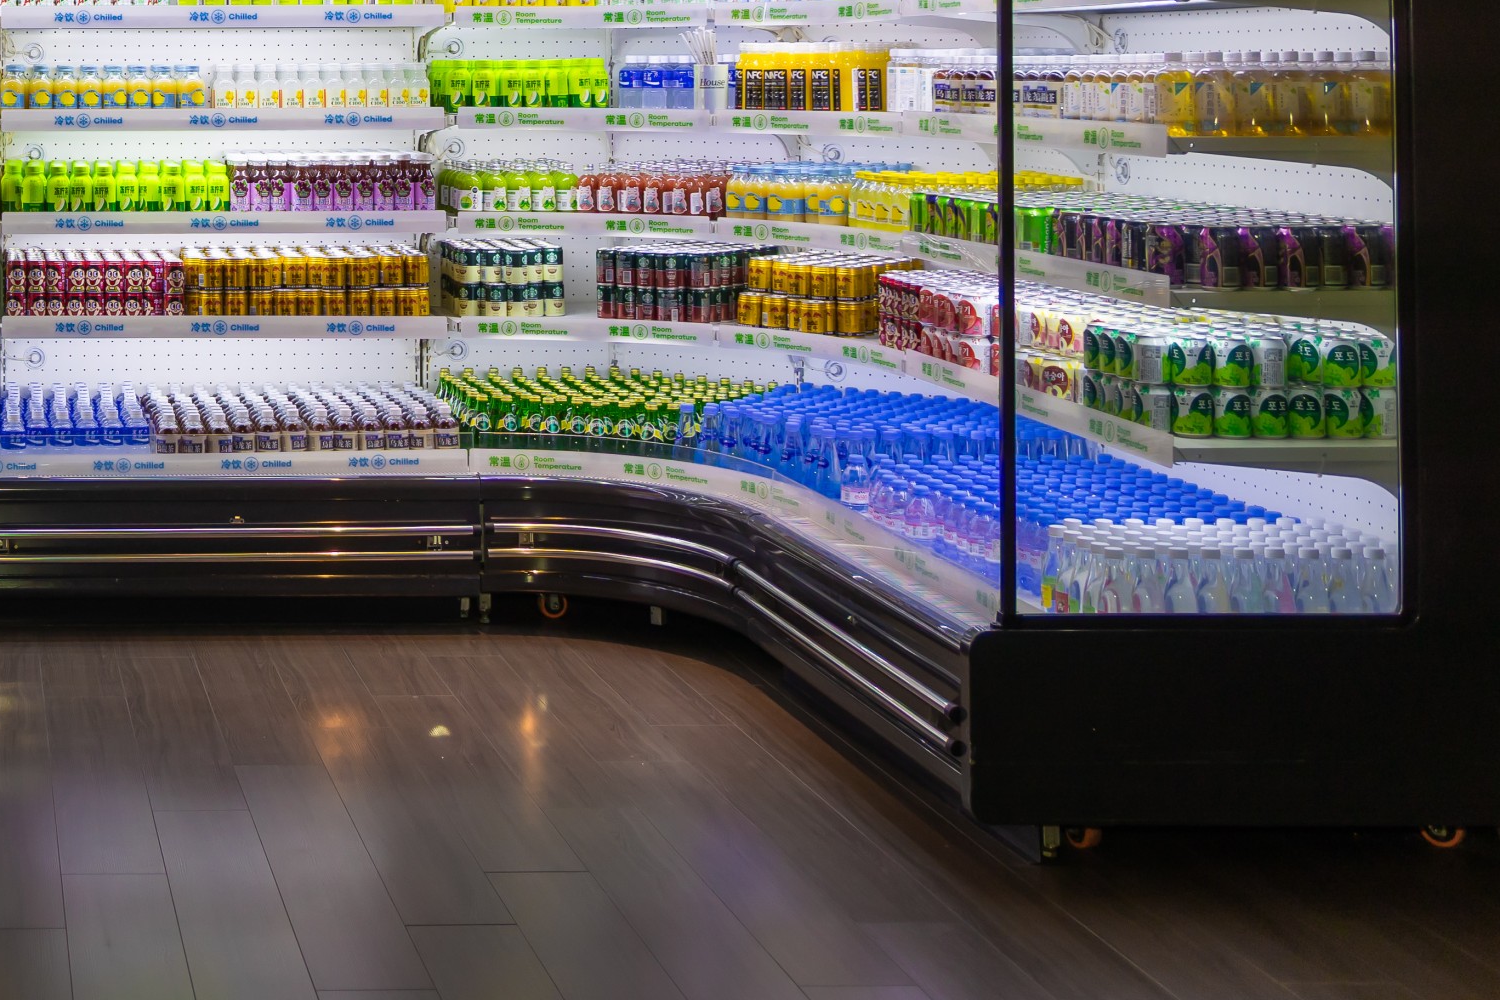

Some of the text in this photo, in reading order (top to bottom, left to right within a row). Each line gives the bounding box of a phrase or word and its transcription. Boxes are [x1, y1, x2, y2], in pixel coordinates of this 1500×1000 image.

[54, 12, 74, 22] 冷饮
[189, 11, 258, 22] 冷饮 Chilled
[324, 11, 393, 21] 冷饮 Chilled
[472, 12, 494, 23] 常温
[603, 12, 624, 22] 常温
[746, 70, 763, 80] NFC
[812, 70, 830, 80] NFC
[699, 78, 726, 88] House
[54, 116, 74, 126] 冷饮
[475, 114, 496, 124] 常温
[605, 115, 626, 125] 常温
[55, 219, 75, 228] 冷饮
[190, 218, 210, 228] 冷饮
[475, 218, 496, 229] 常温
[55, 323, 75, 332] 冷饮
[326, 323, 395, 332] 冷饮 Chilled
[478, 323, 499, 334] 常温
[608, 326, 630, 337] 常温
[651, 326, 673, 334] Room
[652, 332, 697, 340] Temperature
[1334, 351, 1355, 361] 포도
[1295, 401, 1316, 411] 포도
[221, 460, 292, 469] 冷饮 Chilled
[348, 457, 369, 468] 冷饮
[489, 456, 511, 468] 常温
[534, 462, 582, 470] Temperature
[624, 463, 644, 475] 常温
[664, 466, 684, 474] Room
[665, 473, 708, 485] Temperature
